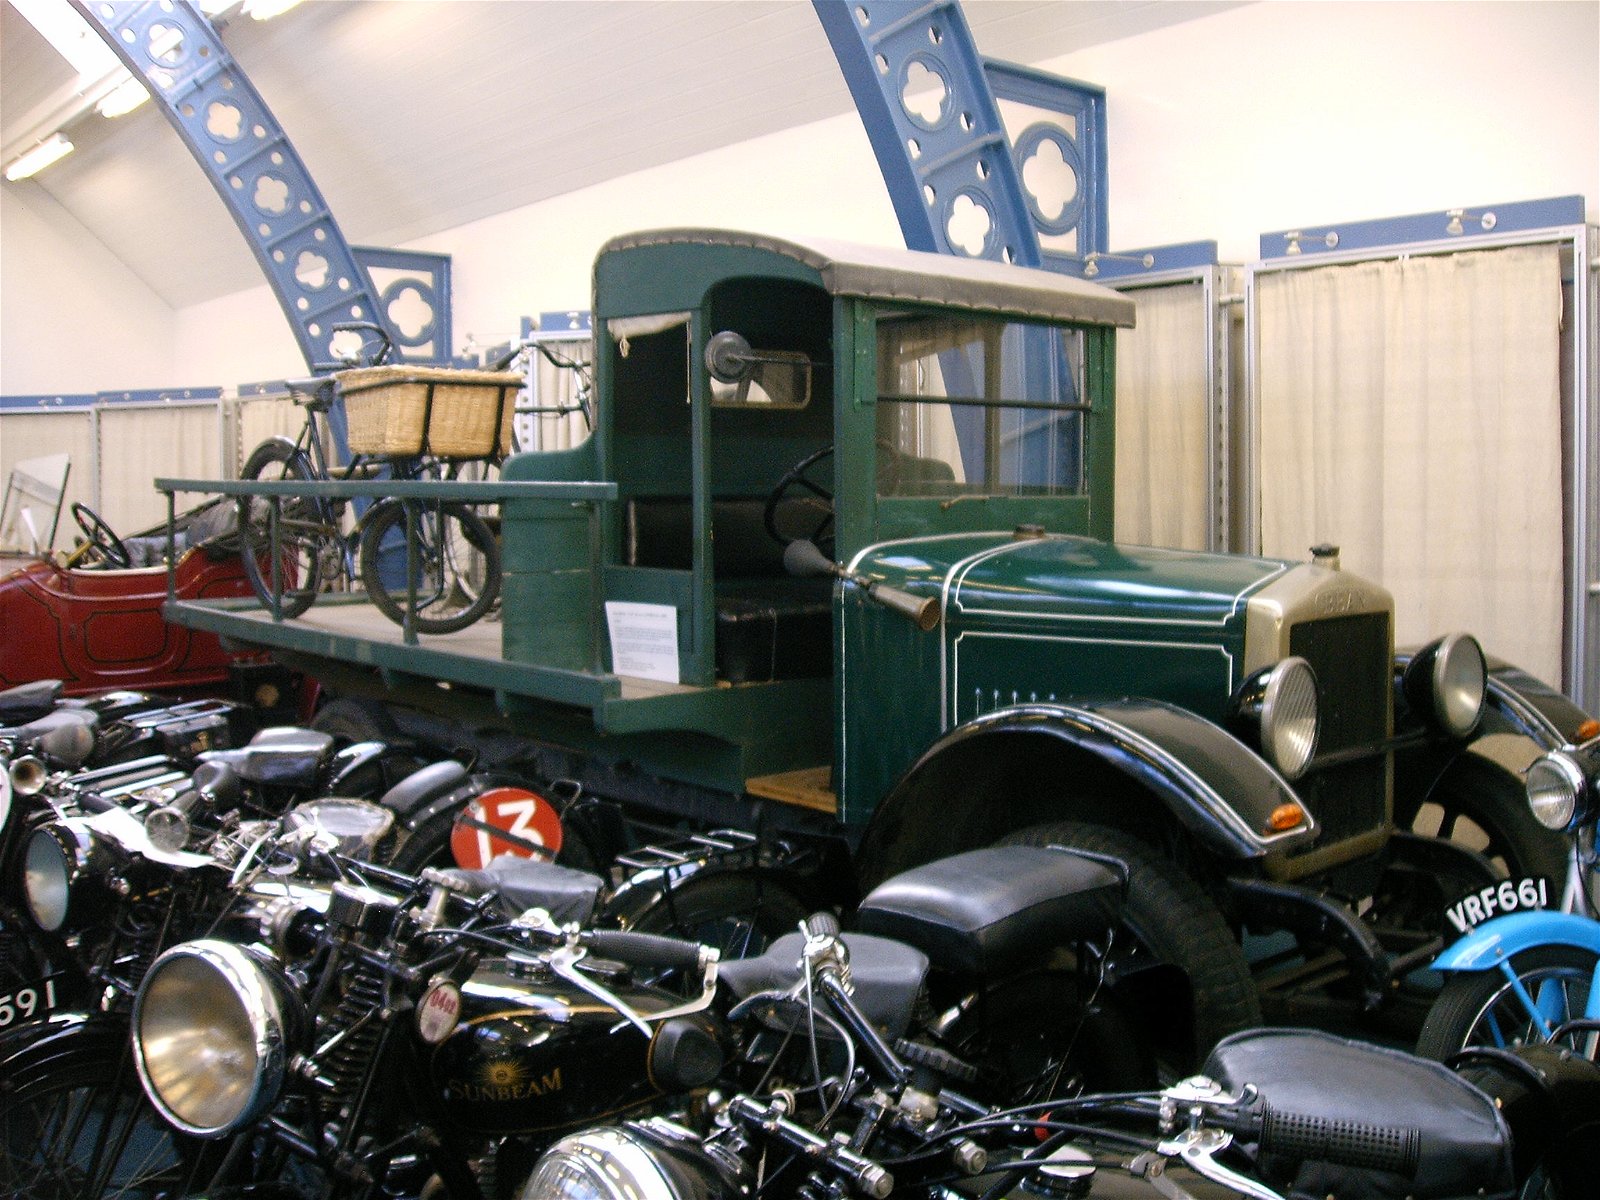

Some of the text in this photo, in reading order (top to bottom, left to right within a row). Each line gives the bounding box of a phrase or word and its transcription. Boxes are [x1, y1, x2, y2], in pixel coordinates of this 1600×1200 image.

[475, 799, 544, 869] 13
[1446, 878, 1547, 933] VRF661
[448, 1067, 562, 1101] SUNBEAM
